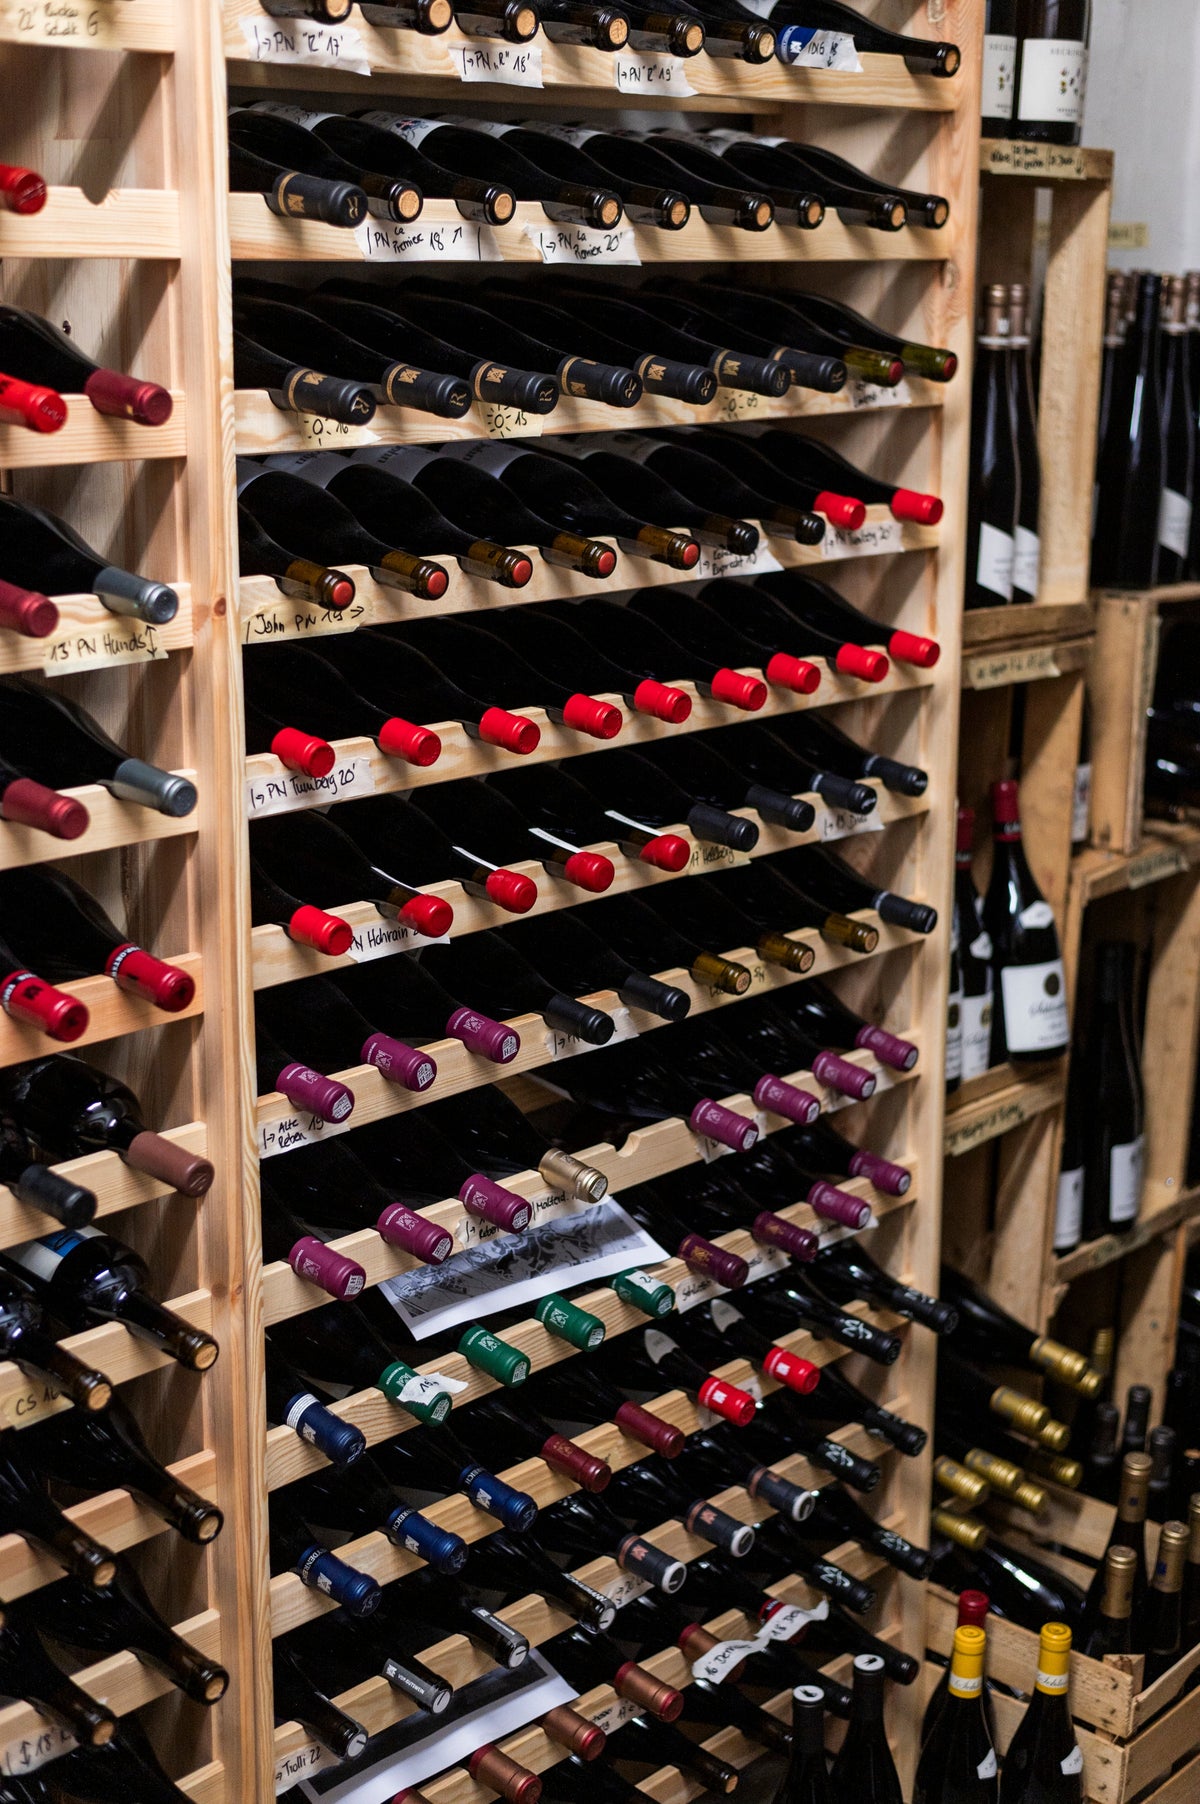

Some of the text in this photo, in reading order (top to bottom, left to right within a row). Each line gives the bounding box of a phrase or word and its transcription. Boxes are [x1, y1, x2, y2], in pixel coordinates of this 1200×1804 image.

[474, 50, 491, 71] PN
[629, 66, 641, 82] PN
[374, 231, 390, 248] PN
[557, 232, 572, 250] PN
[254, 613, 285, 635] John
[295, 613, 317, 631] PN
[77, 638, 97, 657] PN
[103, 632, 146, 655] Hunds
[266, 780, 288, 799] PN
[16, 1393, 37, 1416] CS
